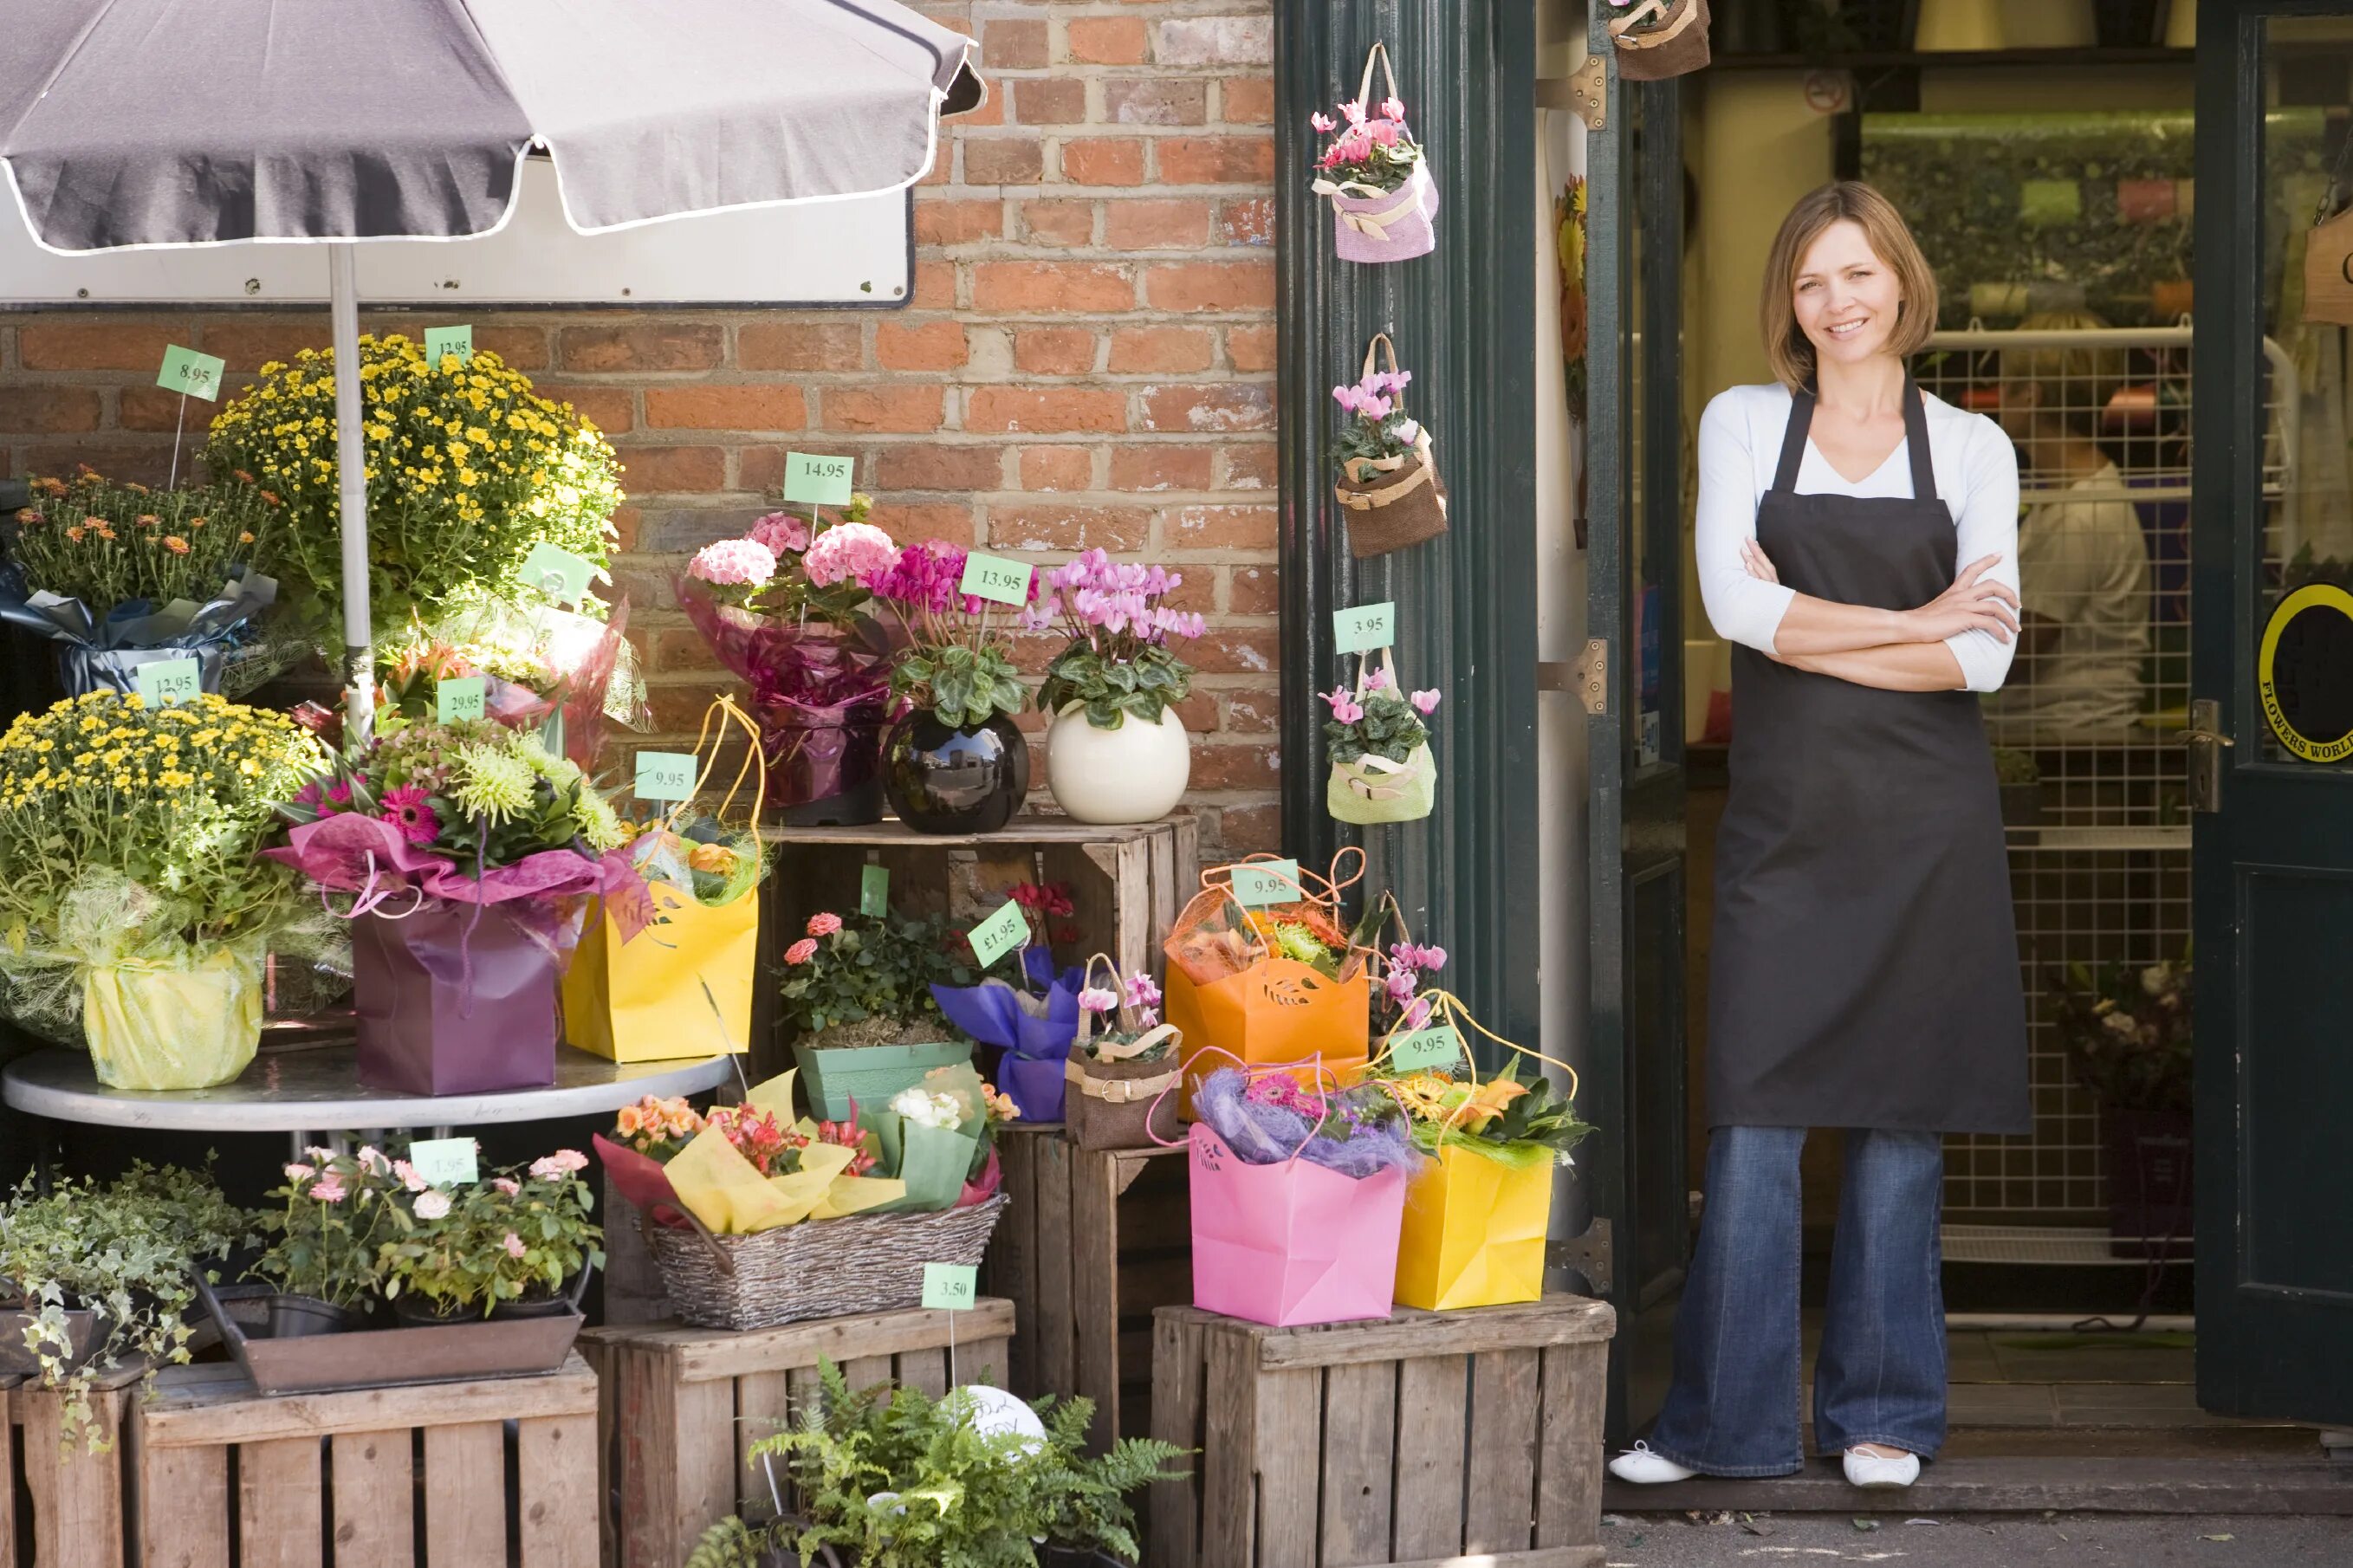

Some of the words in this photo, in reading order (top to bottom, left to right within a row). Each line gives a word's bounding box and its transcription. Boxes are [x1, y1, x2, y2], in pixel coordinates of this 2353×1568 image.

[440, 340, 467, 354] 1295
[179, 364, 211, 384] 8.95
[804, 462, 845, 477] 14.95
[982, 570, 1021, 590] 13.95
[1353, 617, 1383, 634] 395
[156, 676, 192, 693] 1295
[451, 694, 479, 710] 29.95
[2263, 680, 2306, 753] FLOWERS
[655, 771, 684, 787] 9.95
[1254, 878, 1287, 893] 9.95
[983, 918, 1015, 951] £1.95
[1412, 1035, 1445, 1053] 9.95
[940, 1281, 967, 1297] 3.50
